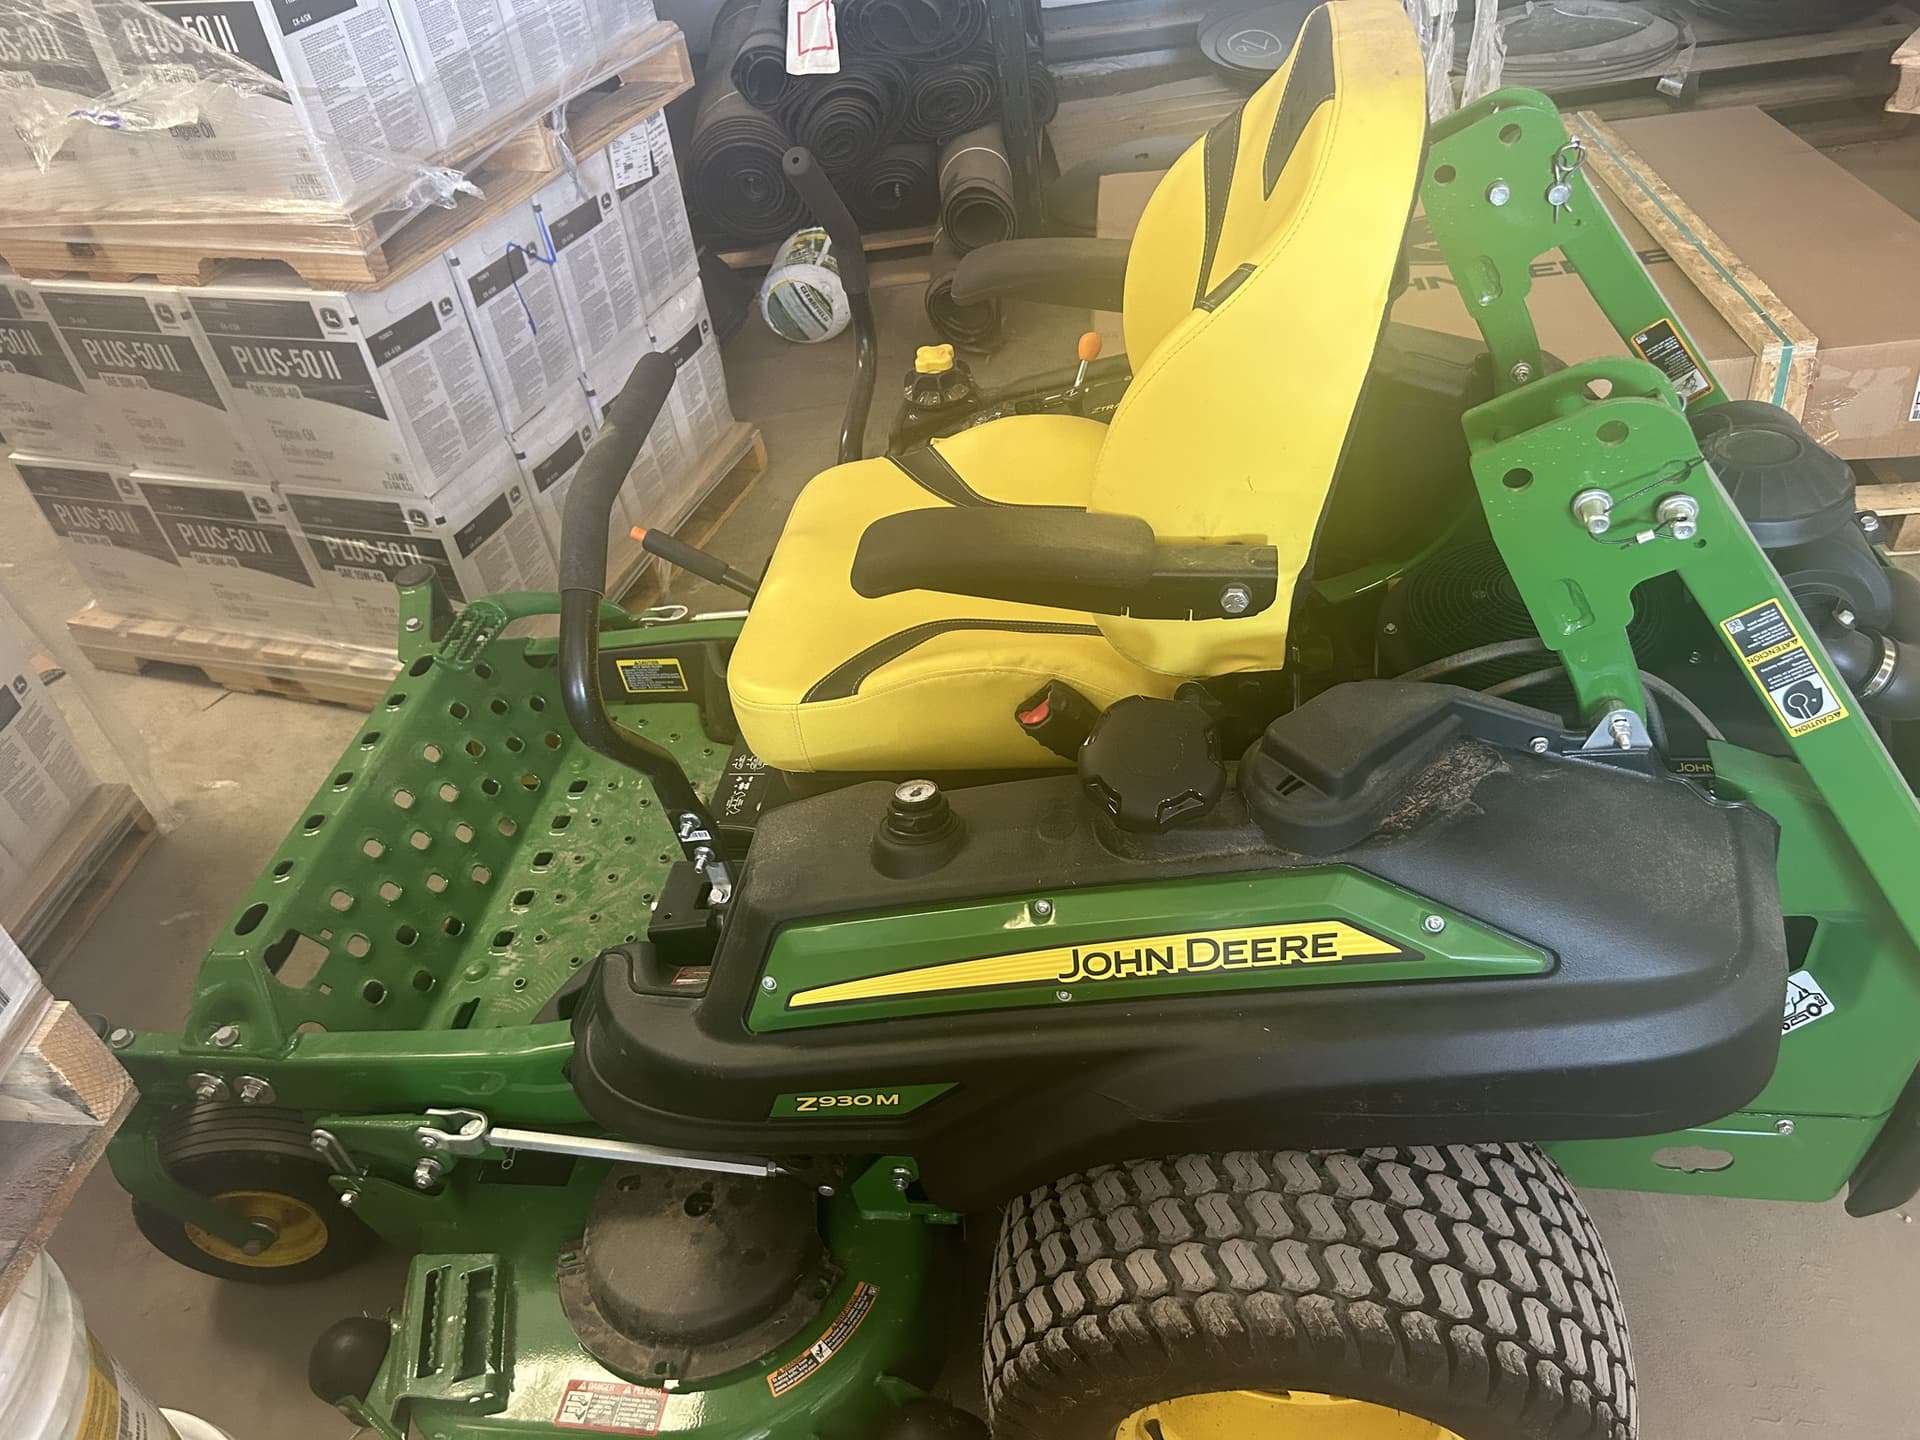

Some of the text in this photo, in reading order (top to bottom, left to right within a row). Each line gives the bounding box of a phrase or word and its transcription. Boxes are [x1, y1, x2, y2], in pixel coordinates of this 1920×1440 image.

[81, 338, 181, 372] PLUS-50 II
[230, 345, 342, 380] PLUS-50 II
[53, 503, 125, 532] PLUS-50
[177, 522, 273, 554] PLUS-50 II
[323, 536, 407, 567] PLUS-50
[1794, 713, 1834, 734] CAUTION
[1059, 932, 1338, 979] JOHN DEERE
